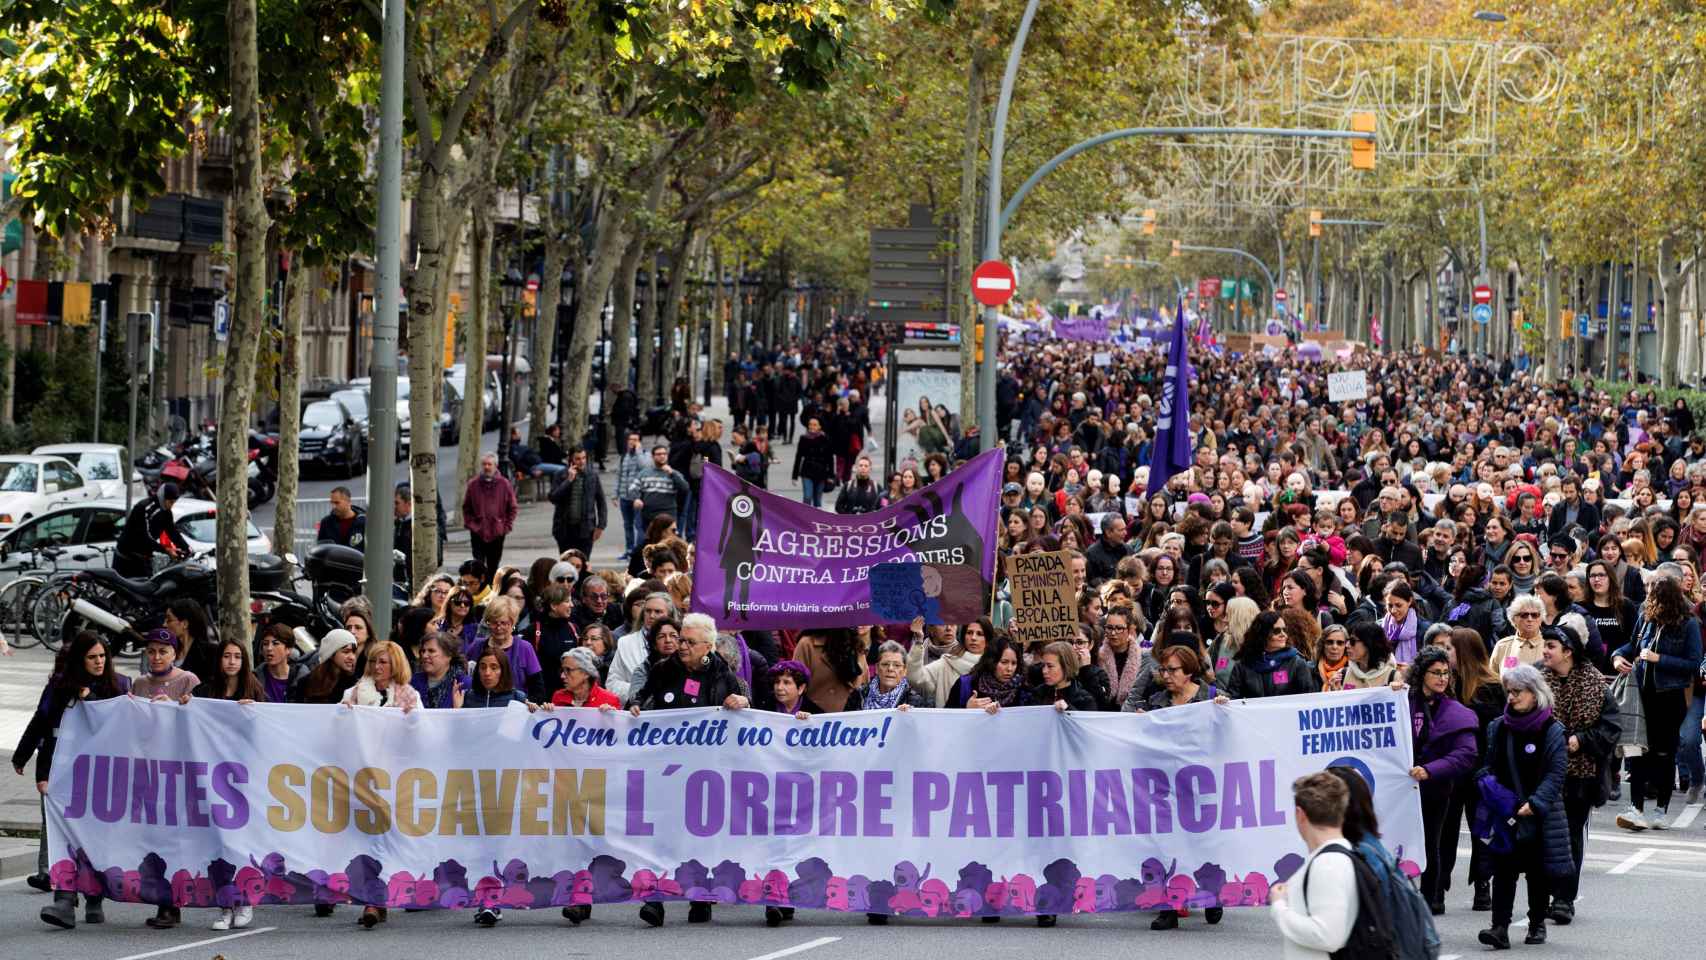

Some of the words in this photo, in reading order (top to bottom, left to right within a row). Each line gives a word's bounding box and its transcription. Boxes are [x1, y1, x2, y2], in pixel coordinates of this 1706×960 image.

[811, 516, 898, 534] PROU
[752, 513, 948, 558] AGRESSIONS
[737, 562, 836, 584] CONTRA
[840, 562, 880, 584] LE
[1015, 555, 1065, 573] PATADA
[1013, 572, 1069, 589] FEMINISTA
[727, 601, 778, 612] Plataforma
[781, 603, 820, 613] Unitària
[822, 602, 854, 613] contra
[856, 600, 870, 609] les
[1051, 606, 1074, 622] DEL
[1017, 623, 1076, 640] MACHISTA
[1298, 702, 1397, 731] NOVEMBRE
[532, 717, 617, 749] Hem
[627, 719, 729, 747] decidit
[737, 725, 773, 746] no
[785, 716, 892, 748] callar!
[1302, 726, 1396, 755] FEMINISTA
[64, 754, 250, 830] JUNTES
[267, 763, 607, 836] SOSCAVEM
[912, 760, 1286, 837] PATRIARCAL
